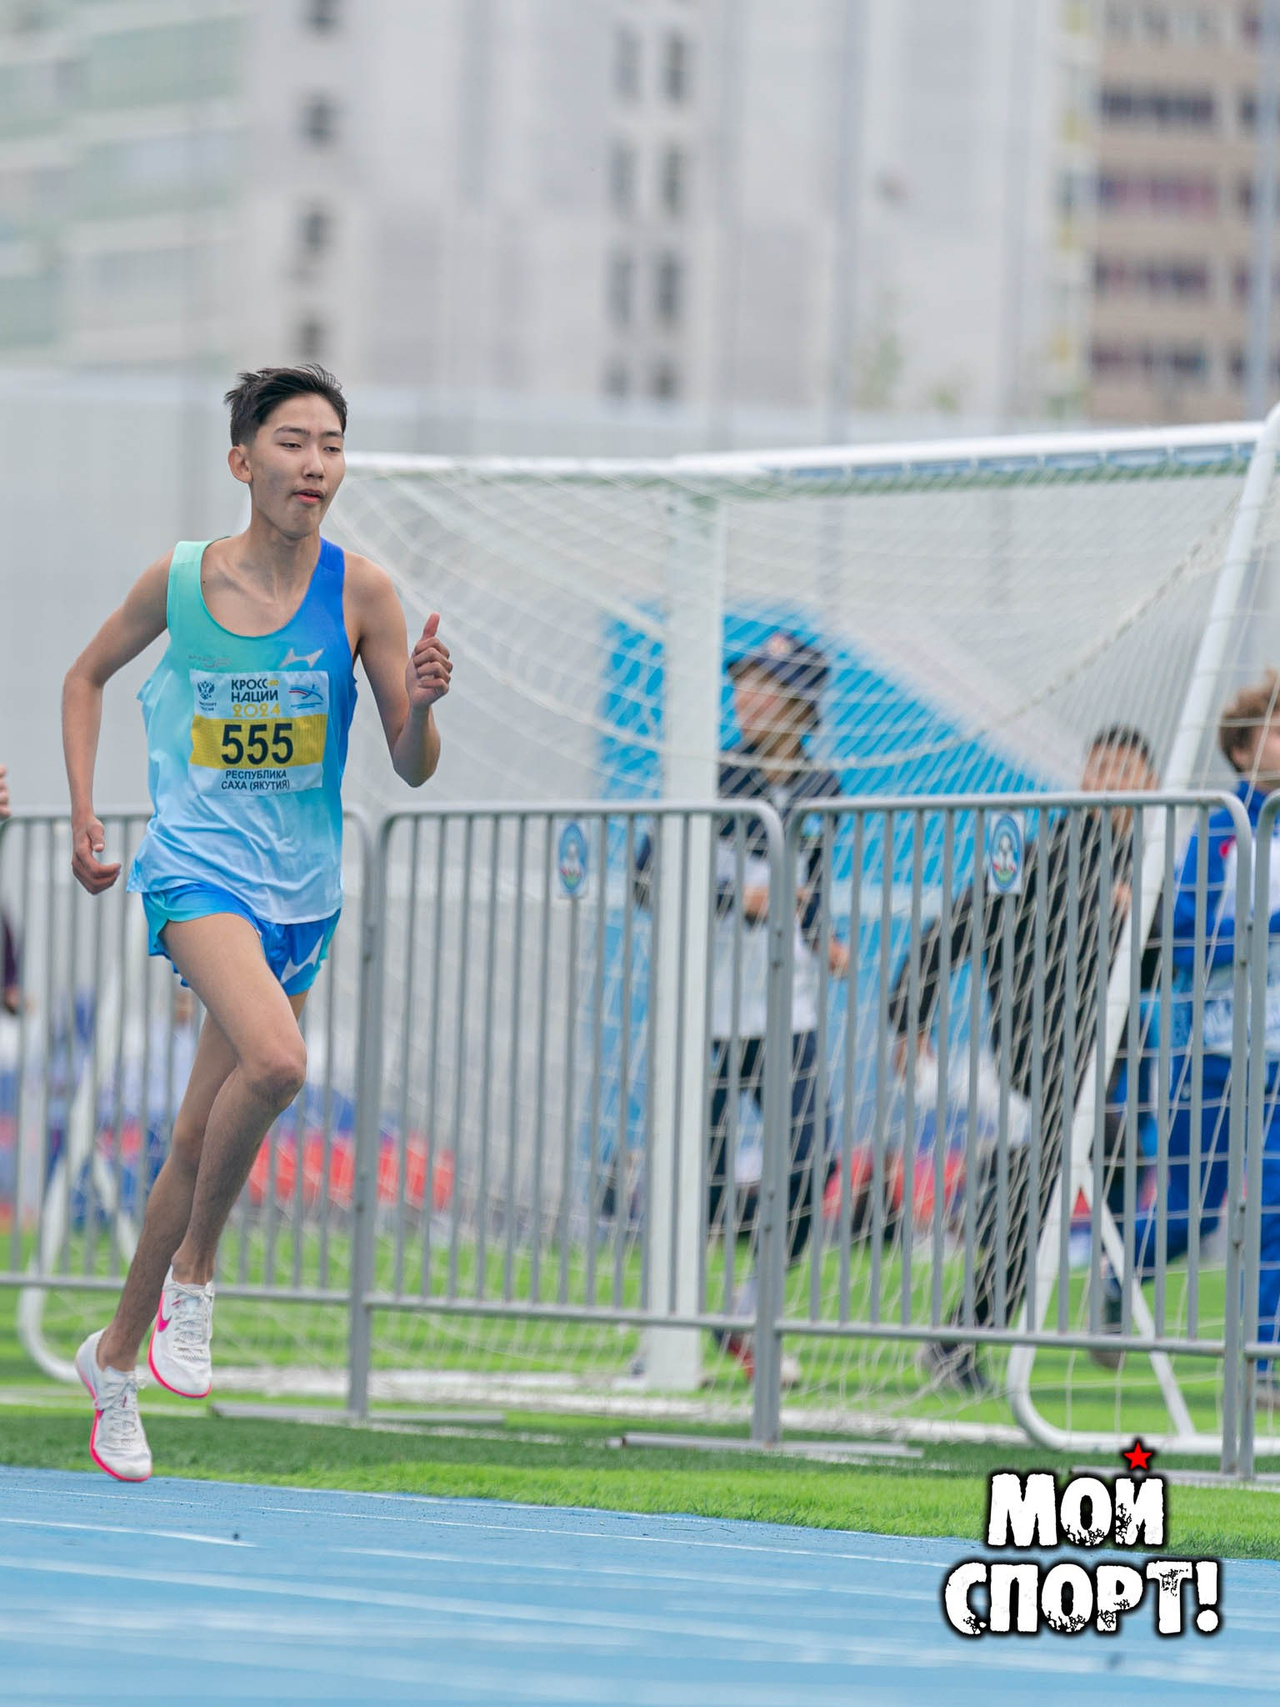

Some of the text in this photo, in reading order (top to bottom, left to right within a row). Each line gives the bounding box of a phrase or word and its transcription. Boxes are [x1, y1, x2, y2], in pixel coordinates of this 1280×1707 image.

[231, 678, 268, 691] КРОСС
[231, 690, 279, 703] НАЦИИ
[232, 703, 281, 718] 2024
[221, 723, 293, 765] 555
[225, 769, 287, 780] РЕСПУБЛИКА
[221, 779, 290, 791] САХА (ЯКУТИЯ)
